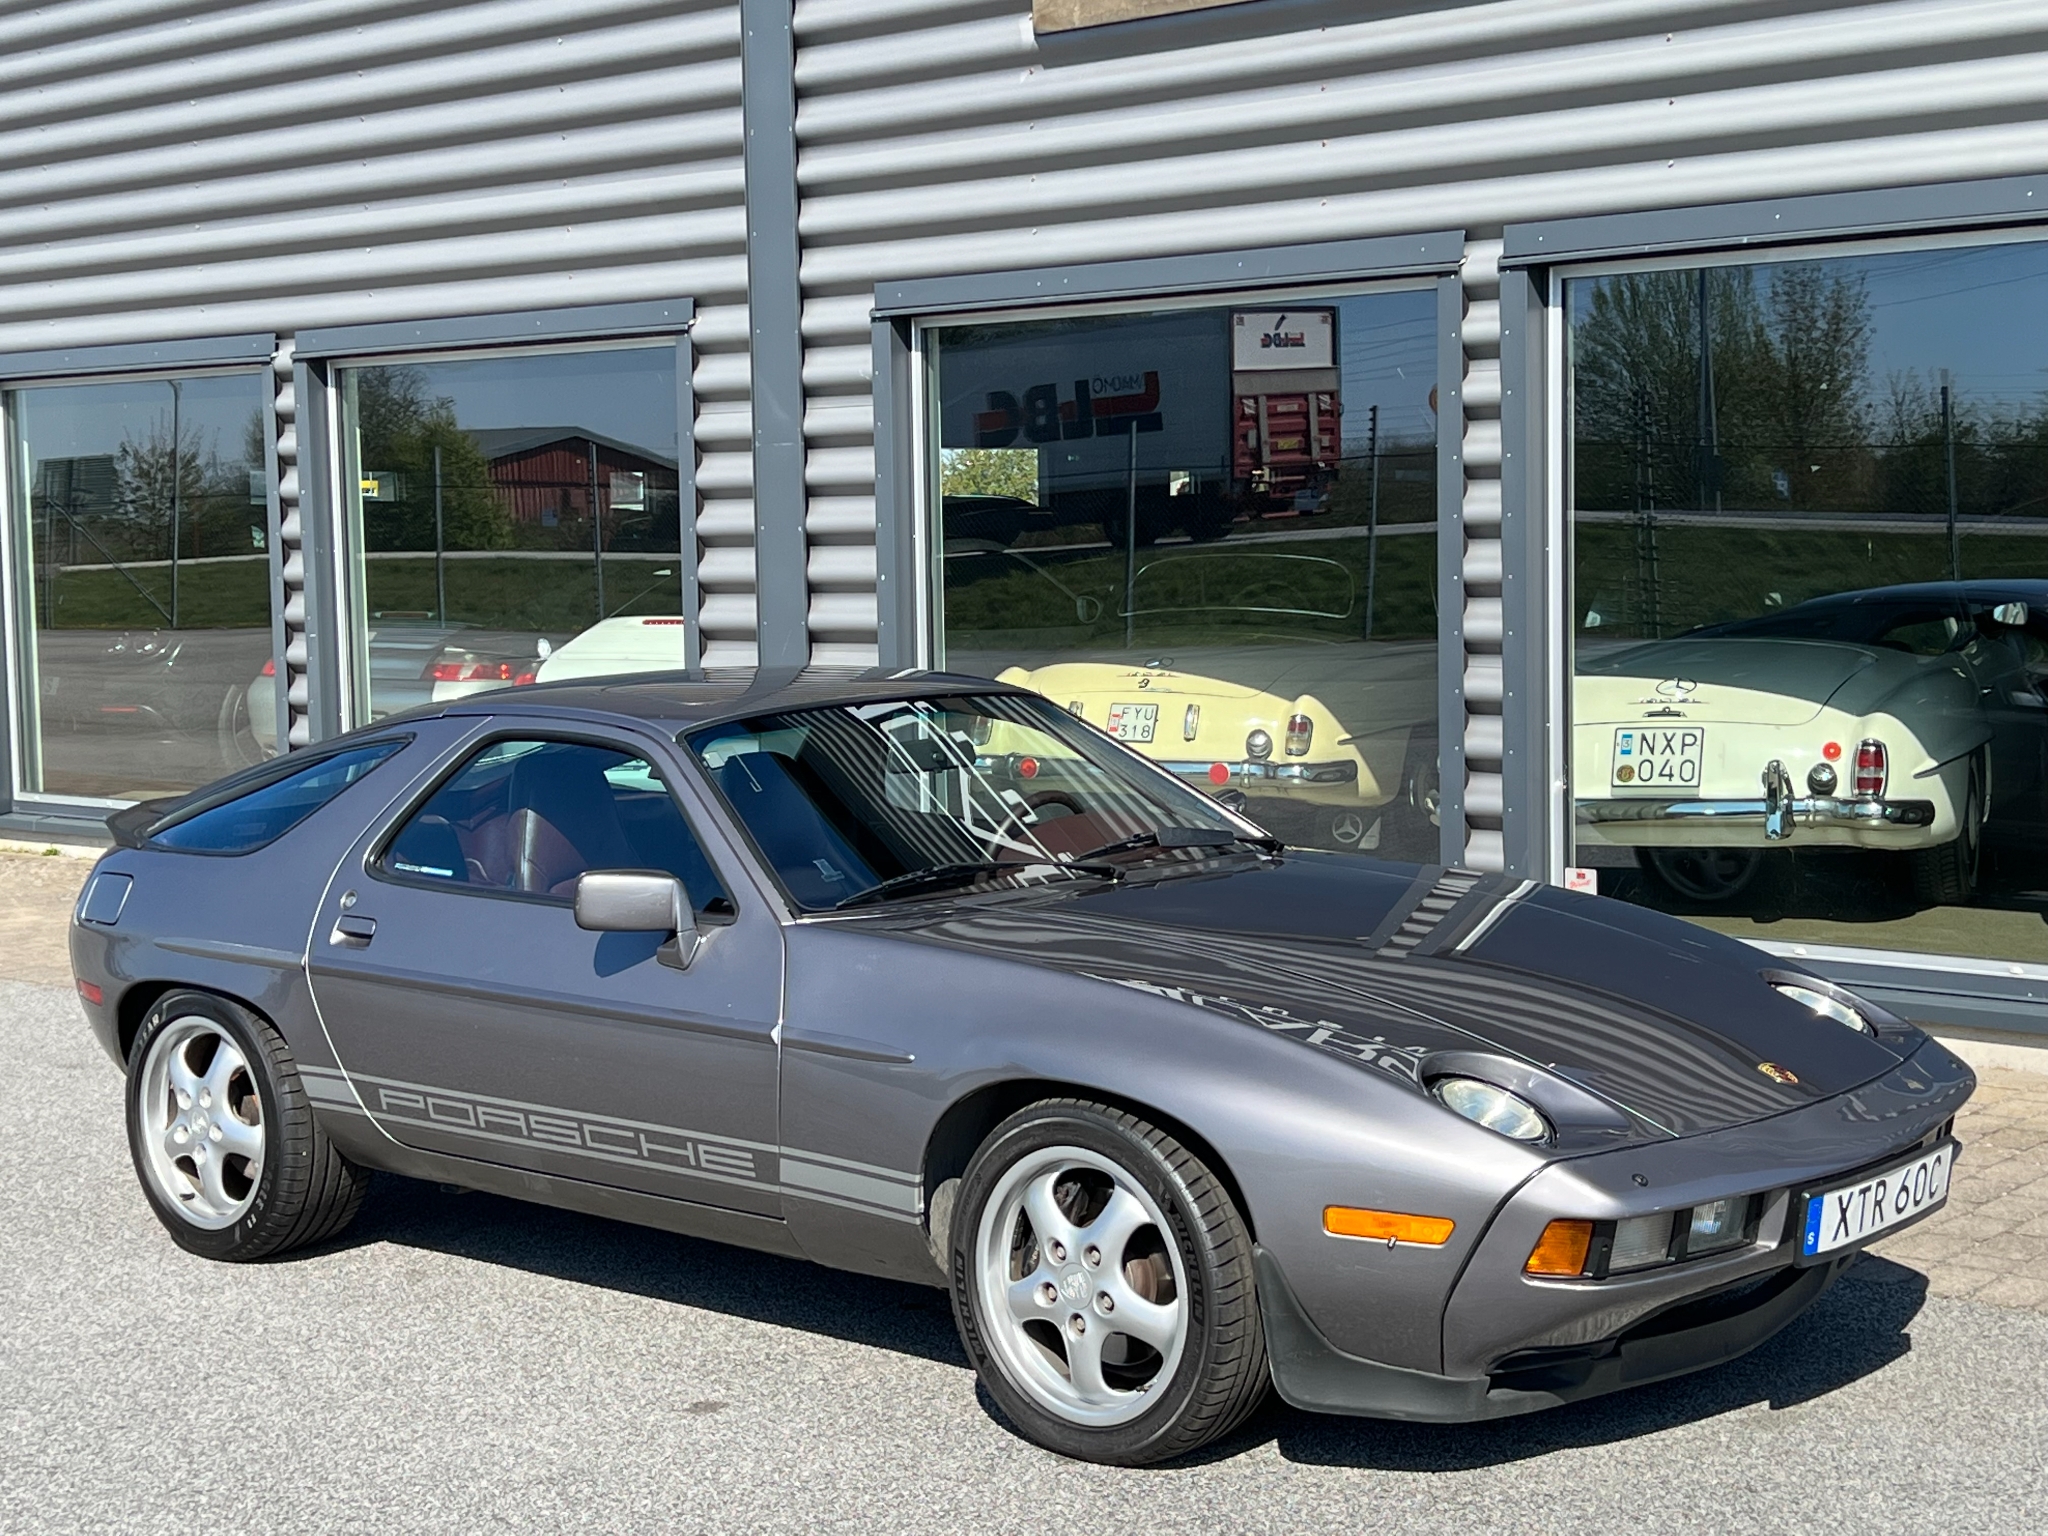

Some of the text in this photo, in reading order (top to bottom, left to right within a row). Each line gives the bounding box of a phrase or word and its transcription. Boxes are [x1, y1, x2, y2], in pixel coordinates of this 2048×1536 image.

[1119, 725, 1151, 739] 318
[1122, 707, 1154, 721] FYU
[1638, 759, 1696, 782] 040
[1639, 732, 1698, 755] NXP
[379, 1088, 756, 1178] PORSCHE
[1832, 1154, 1942, 1241] XTR 60C
[1172, 1213, 1205, 1318] MICHELIN
[955, 1254, 984, 1355] MICHELIN
